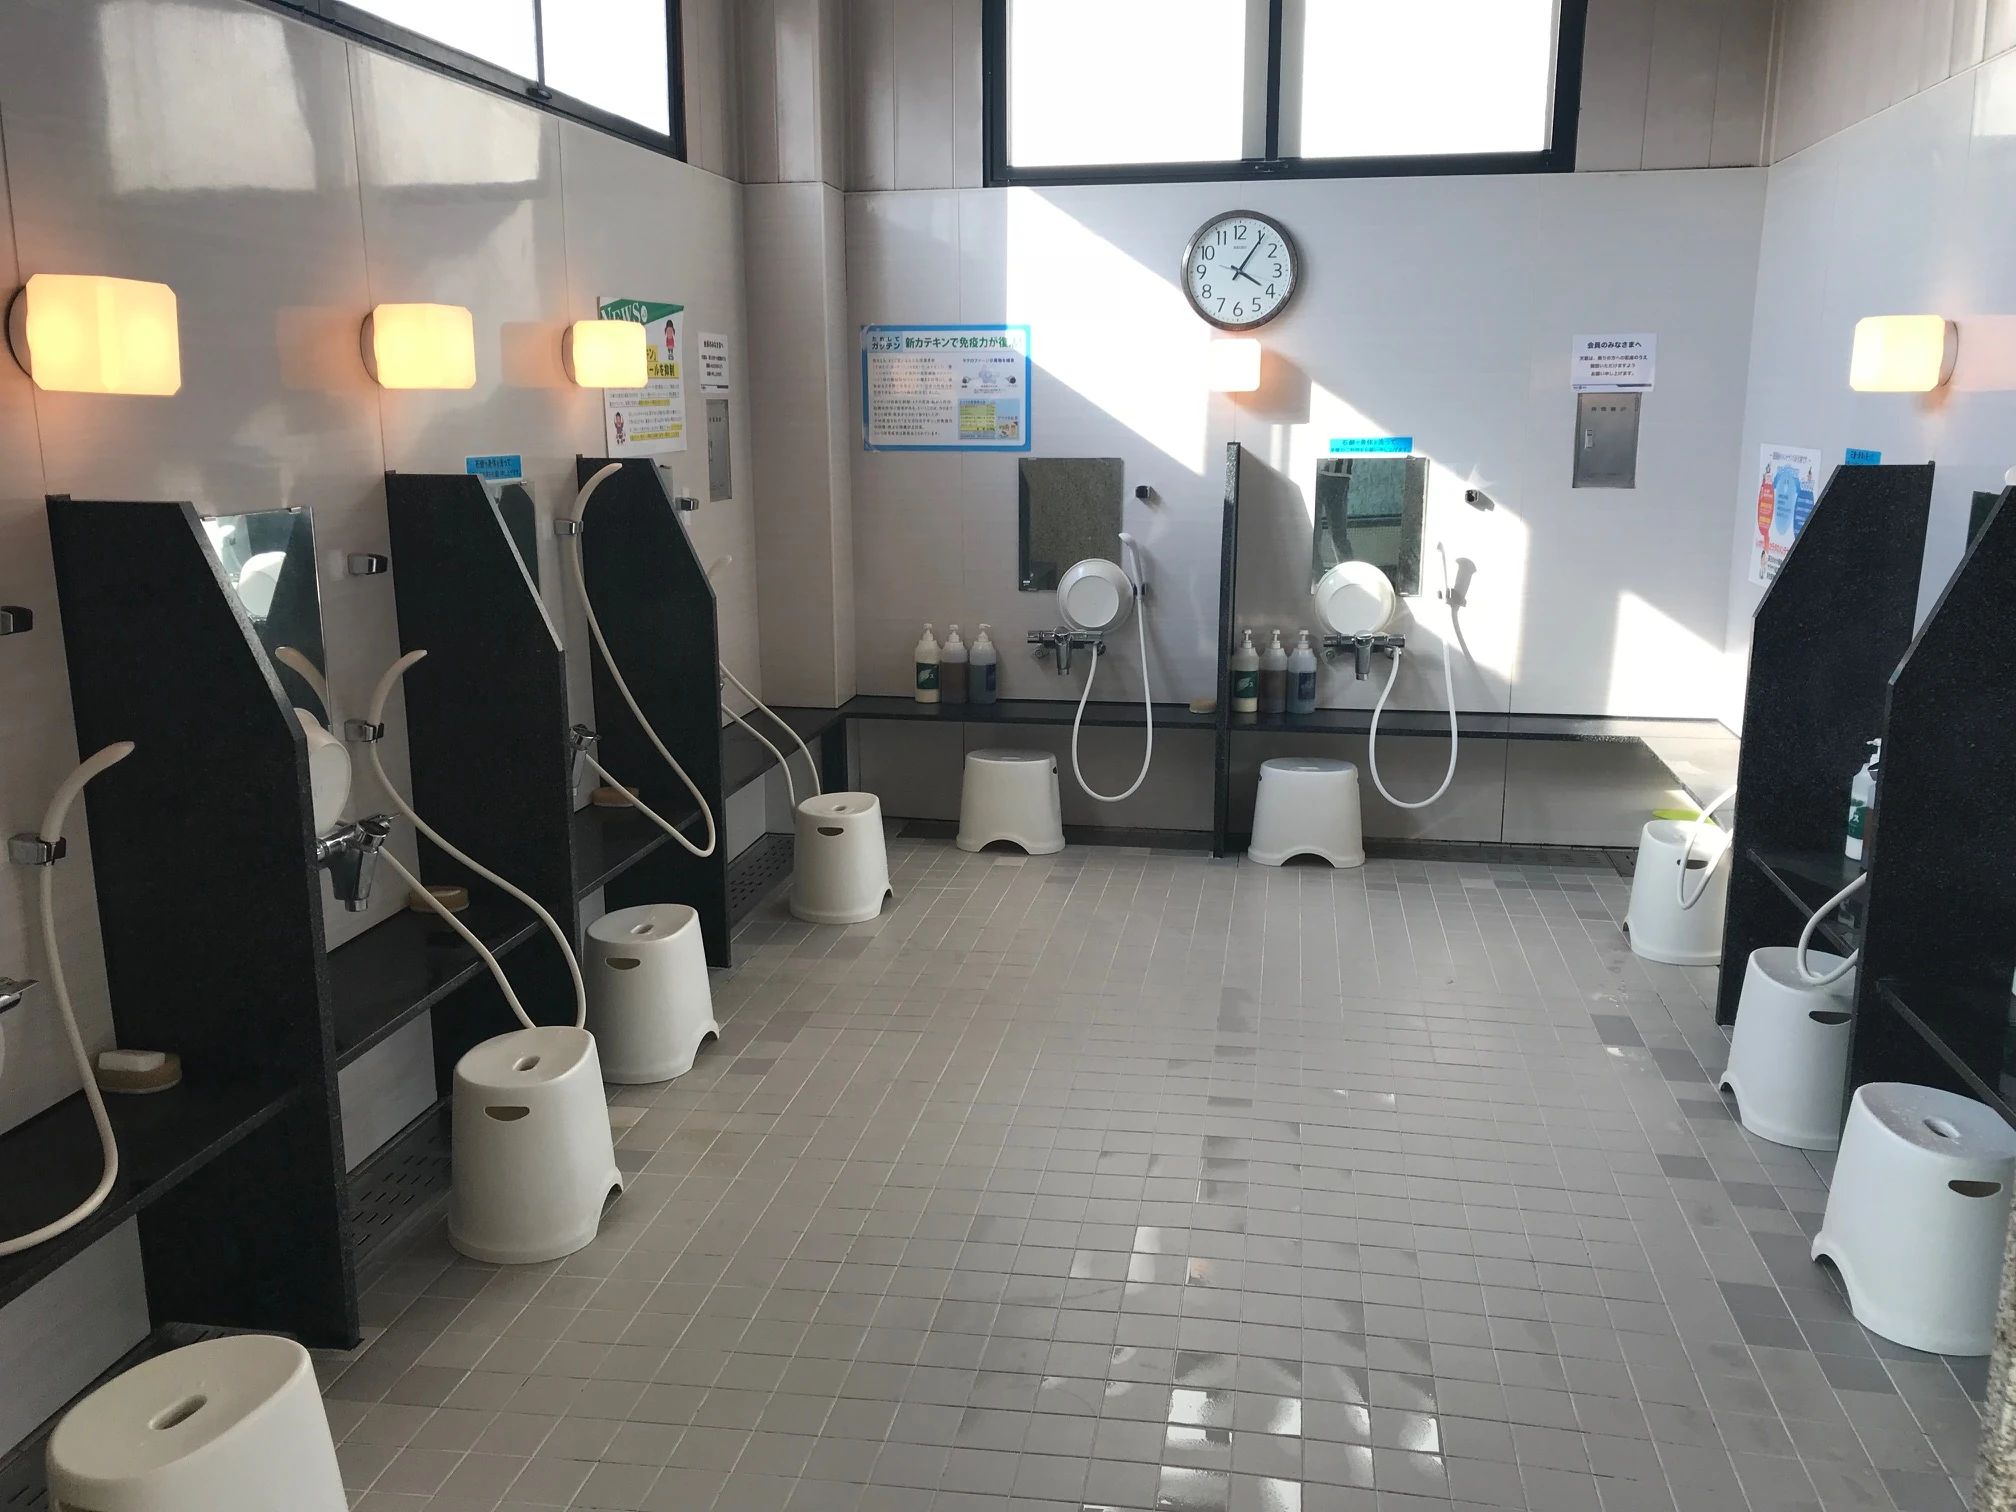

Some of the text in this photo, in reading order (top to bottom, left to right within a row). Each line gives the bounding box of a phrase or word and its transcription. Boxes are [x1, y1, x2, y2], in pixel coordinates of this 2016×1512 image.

[1216, 230, 1227, 245] 11
[1233, 225, 1248, 240] 12
[1201, 245, 1215, 260] 10
[1267, 243, 1277, 258] 2
[1196, 264, 1207, 280] 9
[1272, 263, 1282, 278] 3
[1201, 284, 1212, 299] 8
[1265, 283, 1276, 299] 4
[1216, 297, 1226, 312] 7
[1232, 301, 1243, 316] 6
[1252, 297, 1261, 312] 5
[871, 342, 900, 350] ガッテン
[905, 336, 1022, 349] 新カテキンで免疫力が復
[1587, 341, 1642, 349] 会員のみなさまへ
